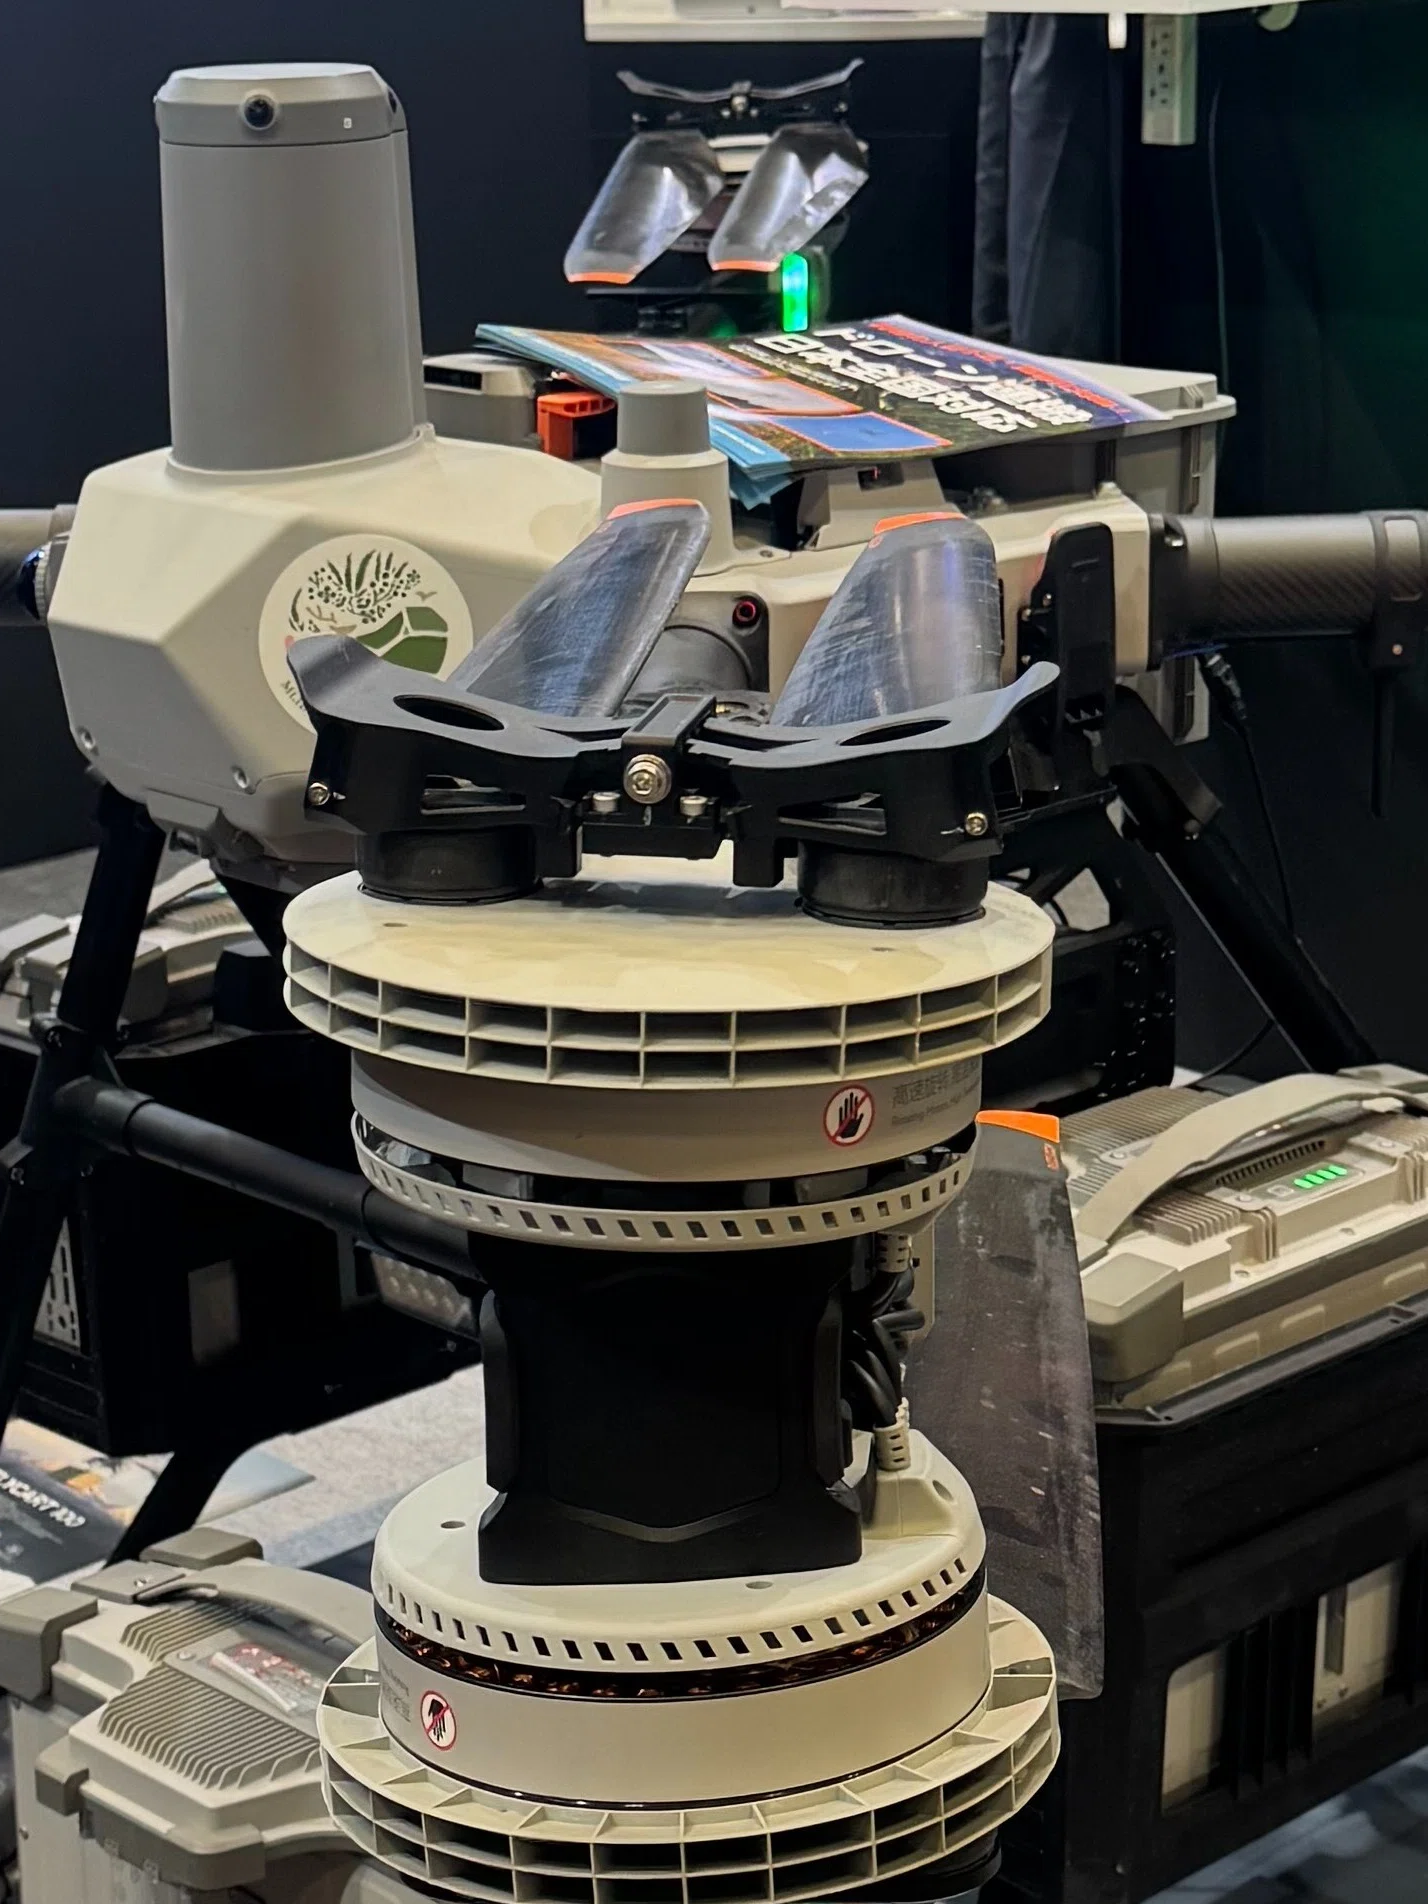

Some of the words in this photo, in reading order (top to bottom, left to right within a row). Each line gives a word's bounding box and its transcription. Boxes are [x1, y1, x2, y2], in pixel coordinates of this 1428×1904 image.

[754, 333, 1038, 434] 日本全国対応
